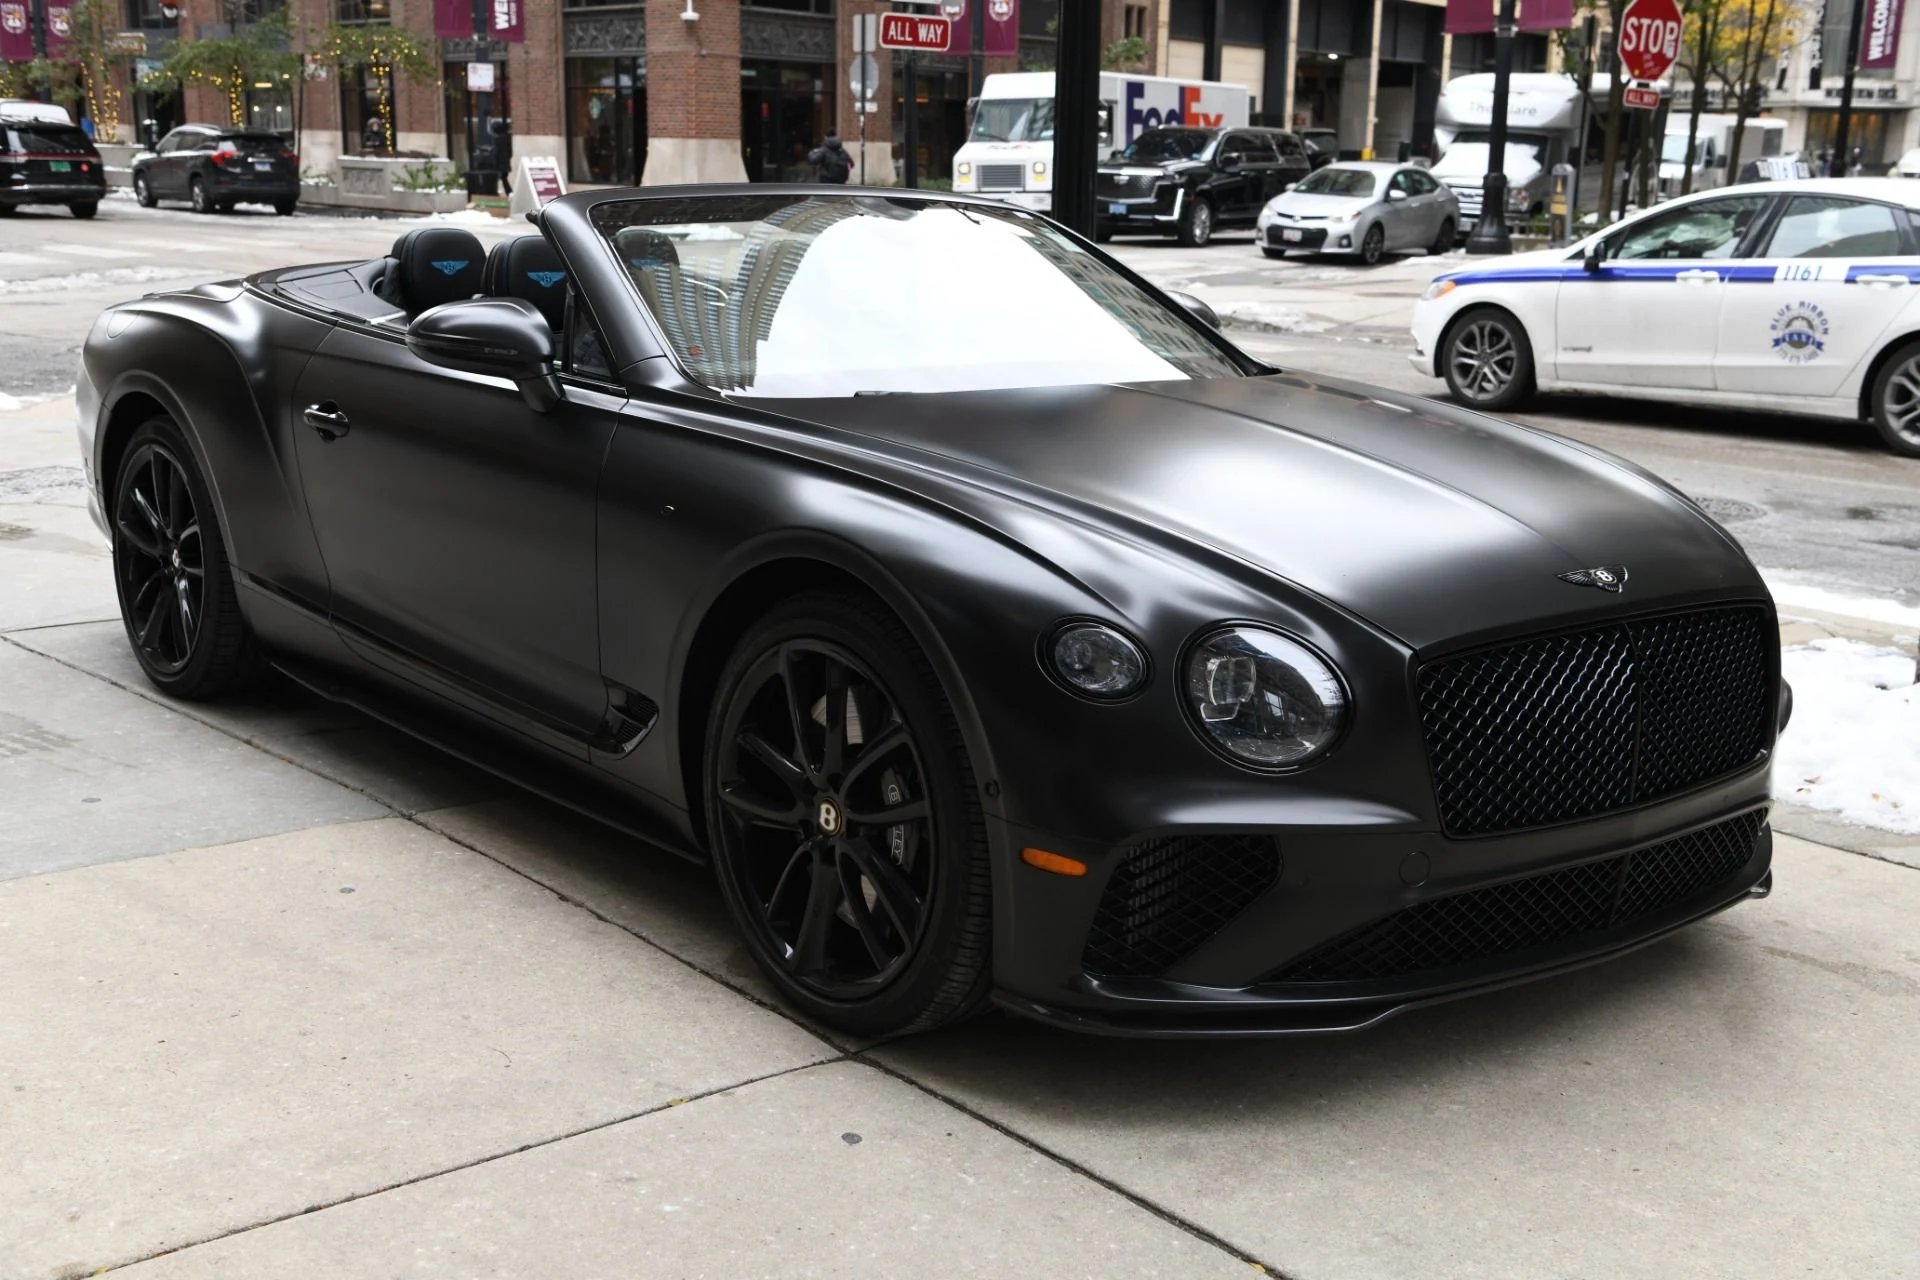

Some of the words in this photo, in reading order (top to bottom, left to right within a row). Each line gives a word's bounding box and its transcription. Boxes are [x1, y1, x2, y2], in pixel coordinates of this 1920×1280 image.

[494, 0, 509, 29] WE
[887, 20, 913, 42] ALL
[917, 22, 944, 43] WAY
[1623, 16, 1679, 55] STOP
[1627, 90, 1641, 102] ALL
[1643, 92, 1657, 104] WAY
[1783, 264, 1823, 281] 1161
[1770, 303, 1792, 331] BLUE
[1799, 300, 1829, 336] RIBBON
[820, 803, 836, 831] B
